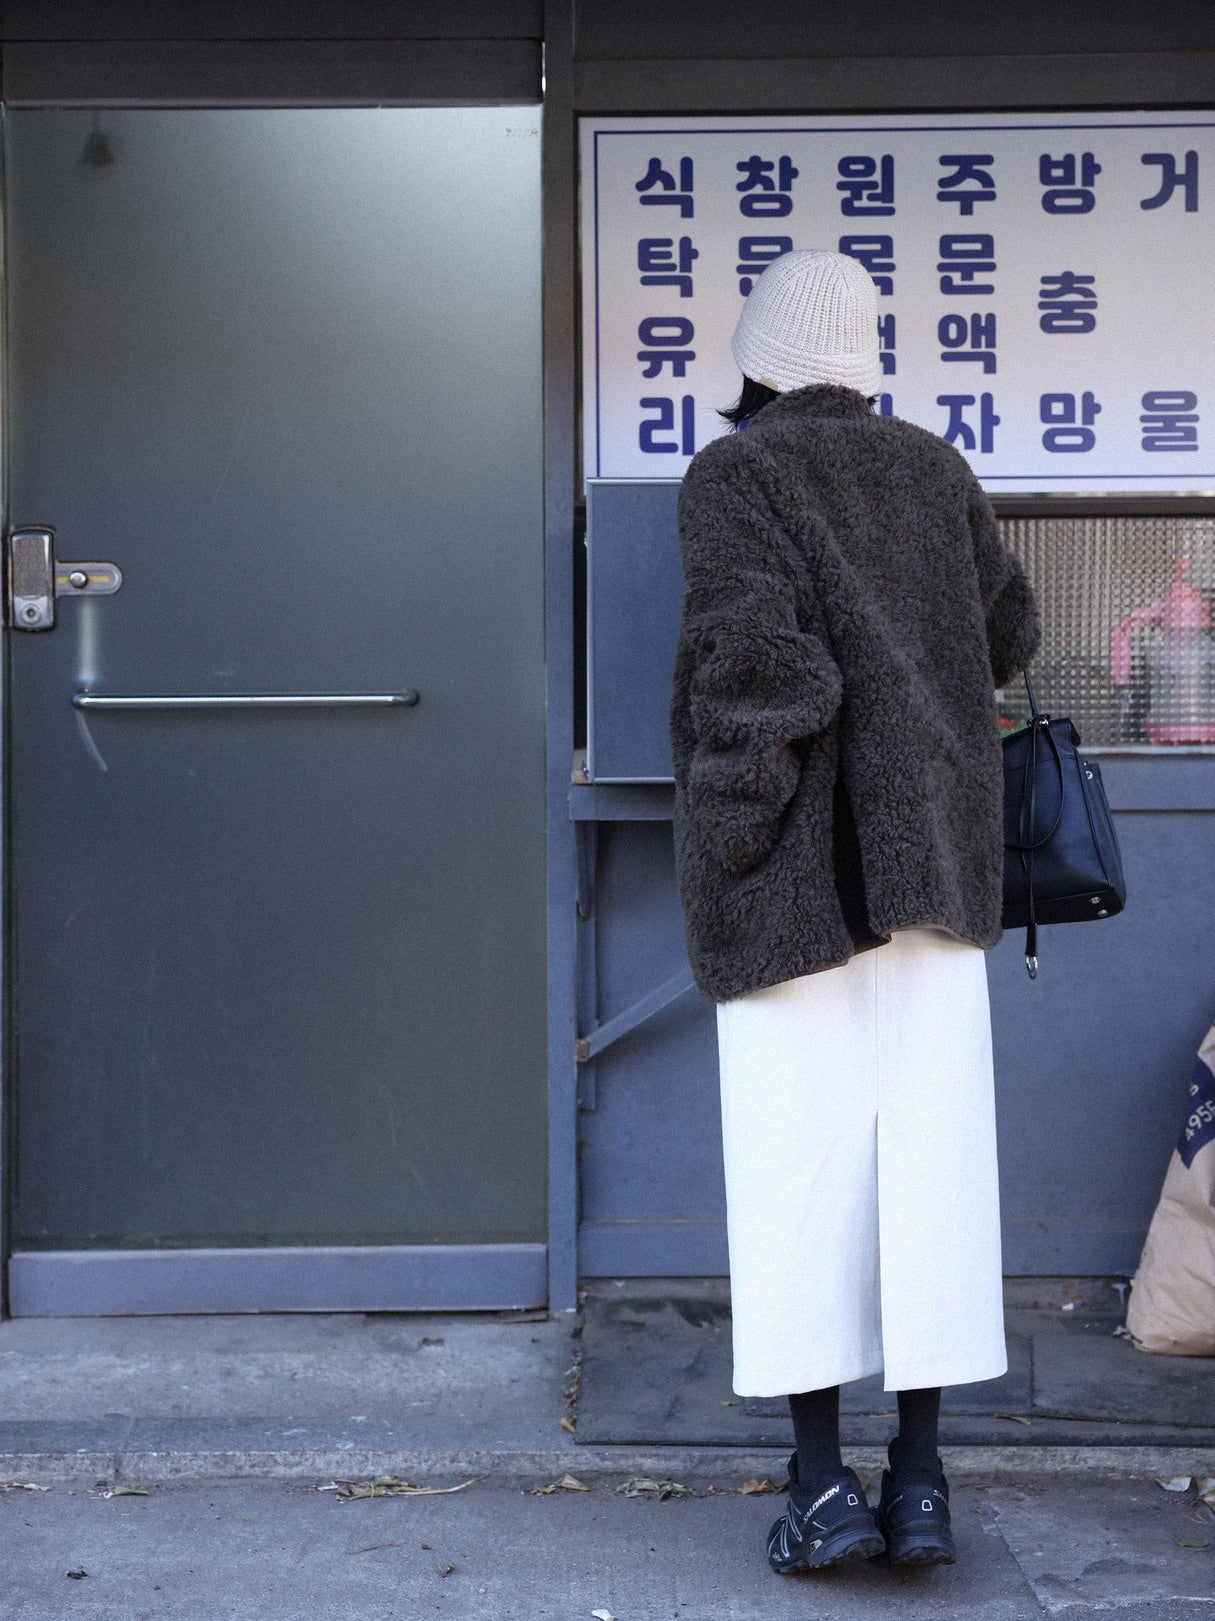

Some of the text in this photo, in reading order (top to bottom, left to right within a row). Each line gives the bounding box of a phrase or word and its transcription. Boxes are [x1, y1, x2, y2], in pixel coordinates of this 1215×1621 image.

[635, 156, 699, 456] 식탁유리
[937, 153, 1001, 454] 주문액자
[1038, 151, 1102, 453] 방충망
[1140, 150, 1199, 452] 거울
